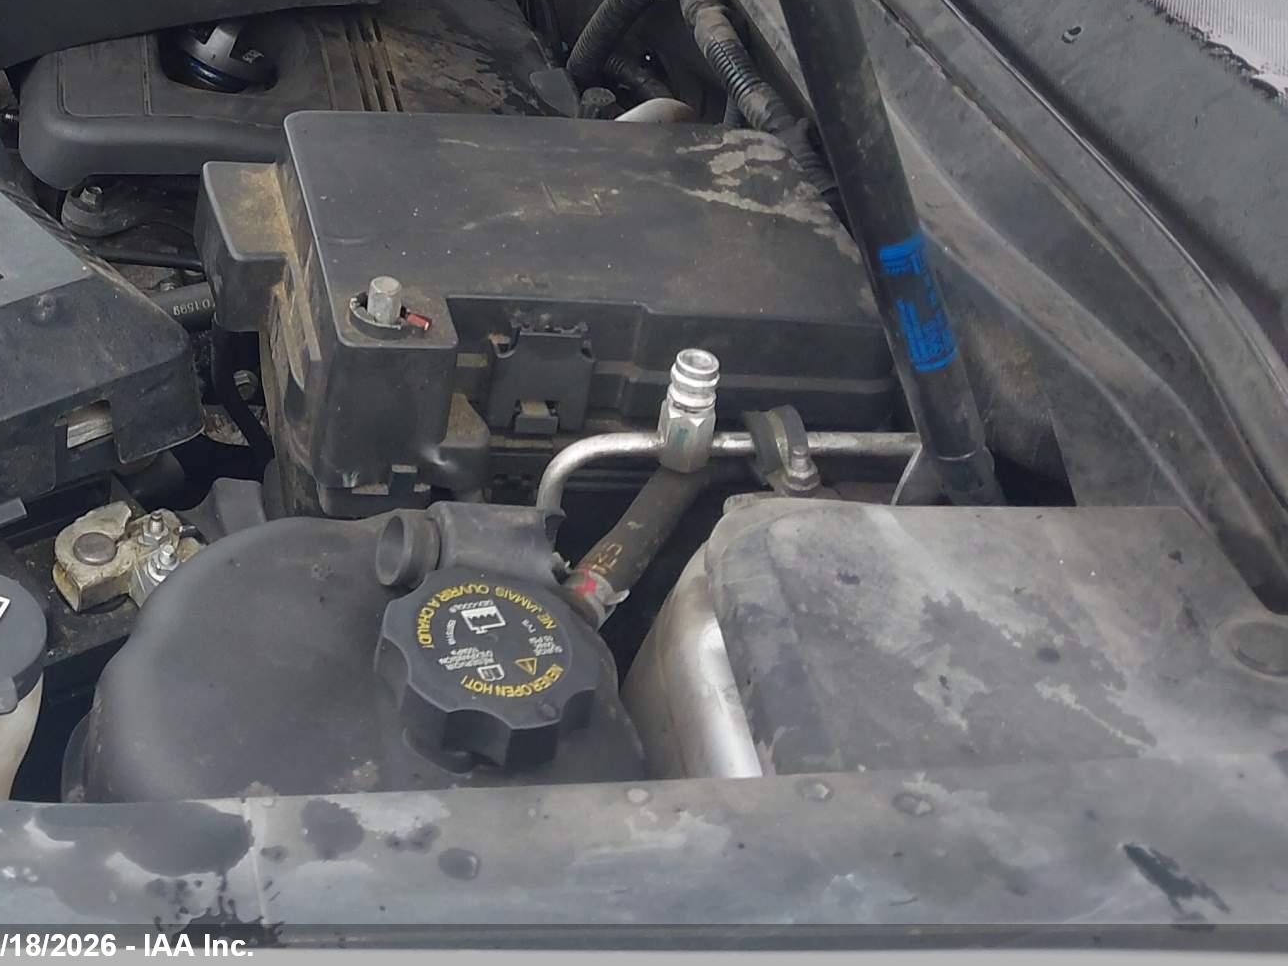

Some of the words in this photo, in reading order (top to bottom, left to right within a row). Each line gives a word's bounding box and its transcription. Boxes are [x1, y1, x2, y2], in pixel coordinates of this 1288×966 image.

[495, 586, 543, 613] JAMAIS
[537, 613, 557, 630] NE
[495, 684, 533, 698] OPEN
